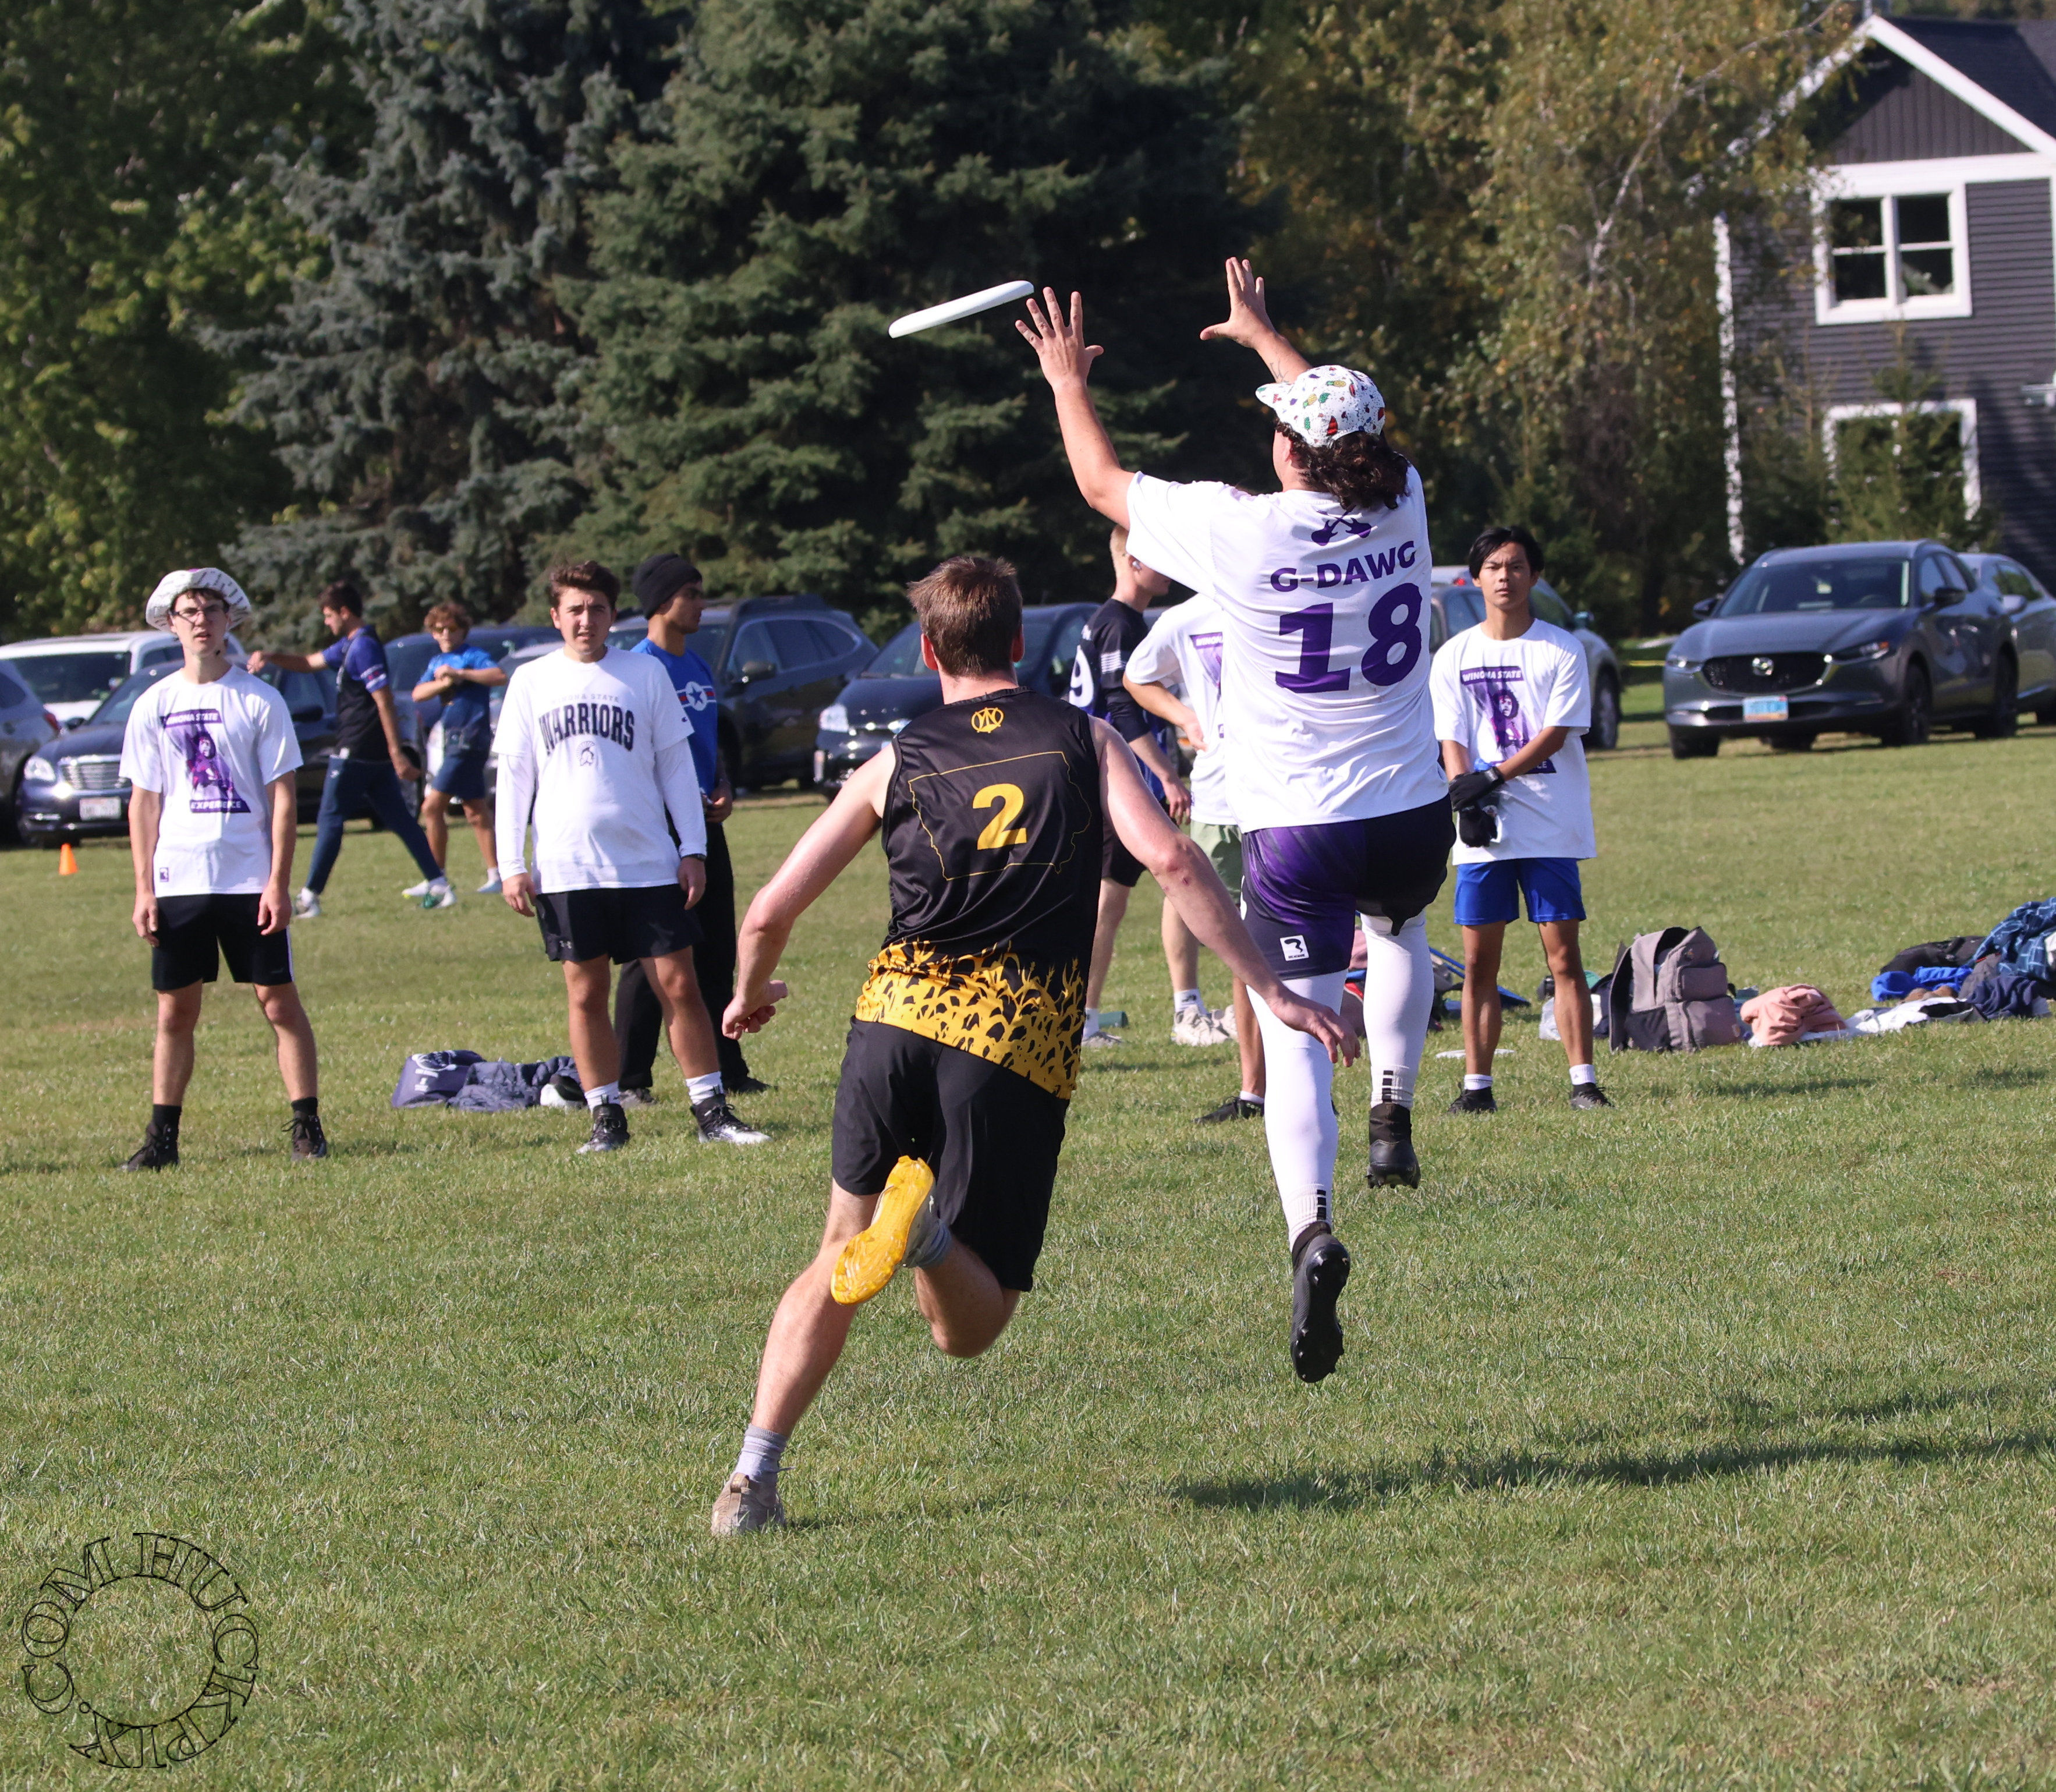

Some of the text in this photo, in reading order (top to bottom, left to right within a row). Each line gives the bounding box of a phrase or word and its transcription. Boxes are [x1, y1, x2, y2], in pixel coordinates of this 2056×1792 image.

[1270, 540, 1417, 593] G-DAWG
[1196, 635, 1223, 646] WINON
[1275, 582, 1423, 694] 18
[590, 693, 619, 703] STATE
[1069, 644, 1094, 707] 9
[1498, 670, 1522, 679] STATE
[538, 703, 635, 756] WARRIORS
[972, 783, 1027, 851] 2
